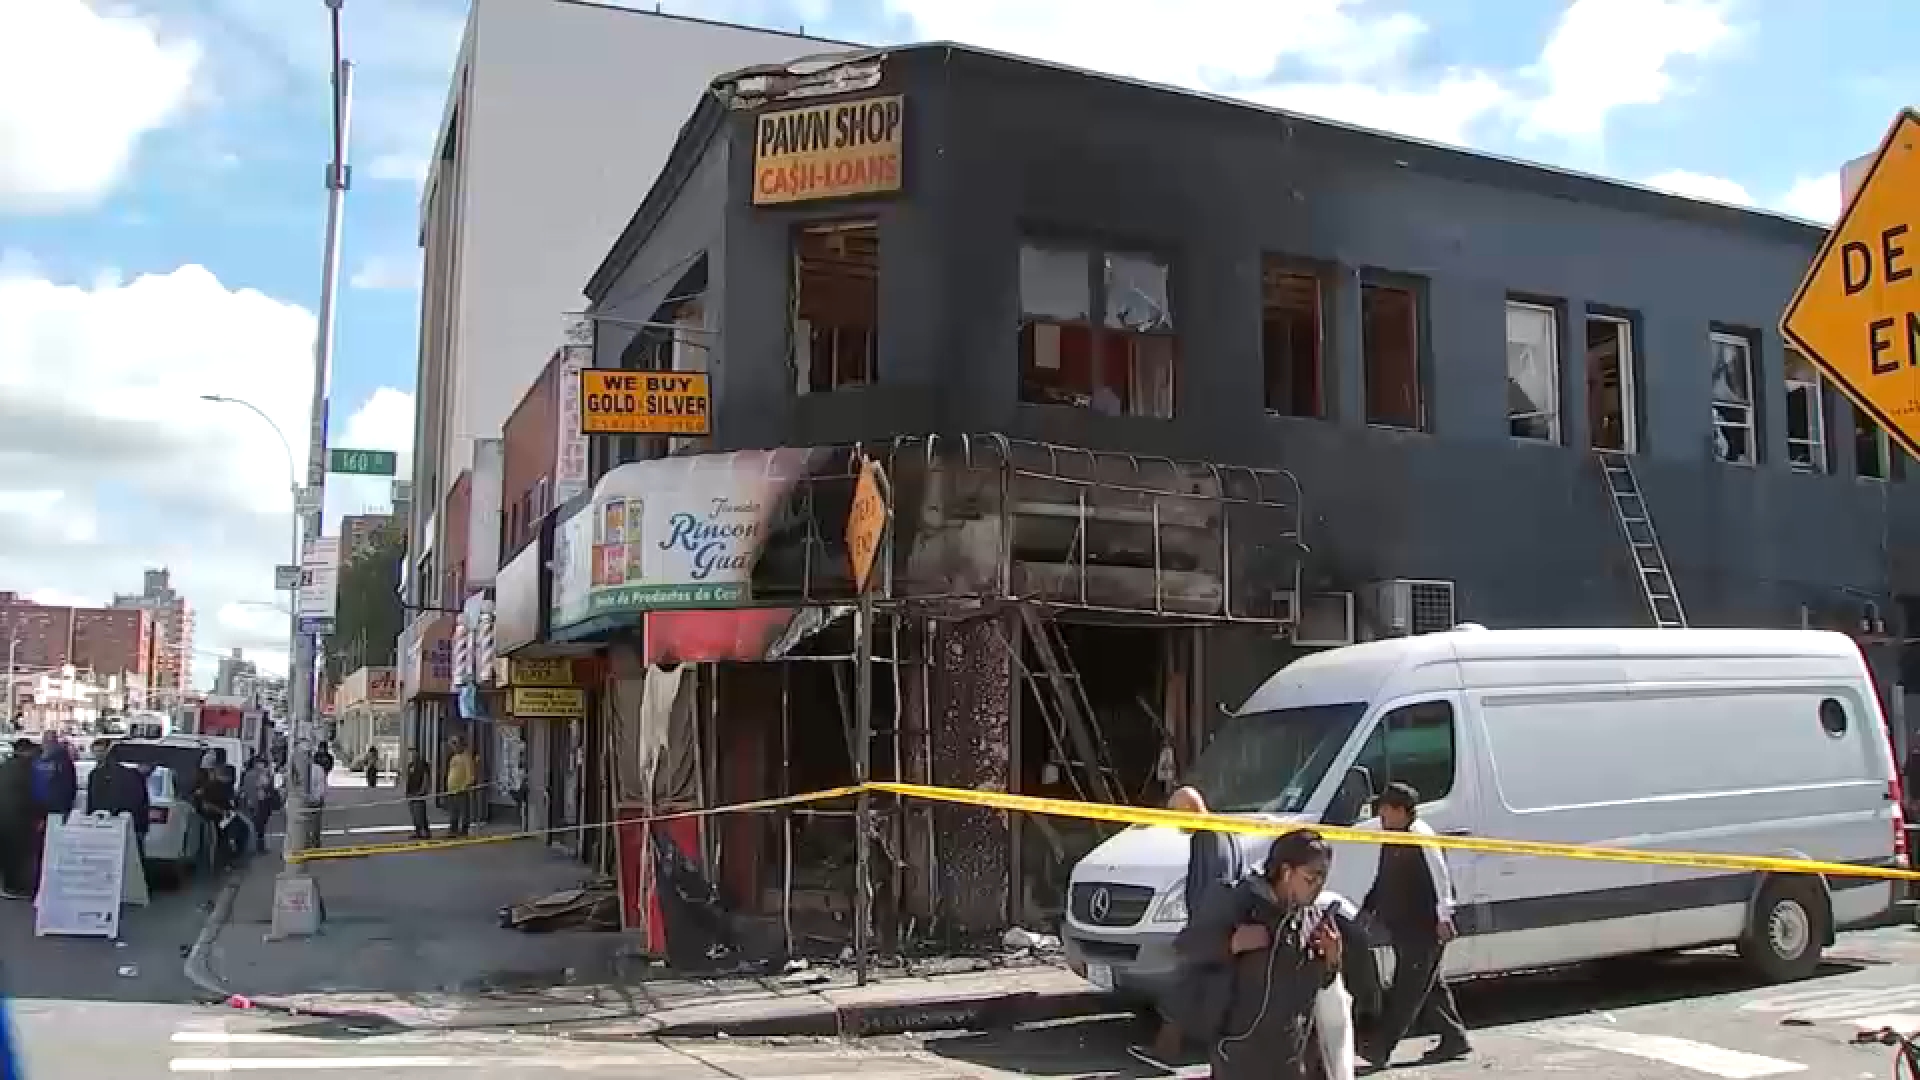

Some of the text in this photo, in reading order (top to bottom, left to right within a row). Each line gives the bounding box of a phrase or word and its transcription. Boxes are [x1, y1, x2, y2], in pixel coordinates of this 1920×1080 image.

[760, 101, 899, 157] PAWN SHOP
[603, 375, 692, 393] WE BUY
[588, 393, 635, 414] GOLD
[647, 394, 706, 415] SILVER
[343, 451, 369, 471] 160
[658, 512, 762, 551] Rincon
